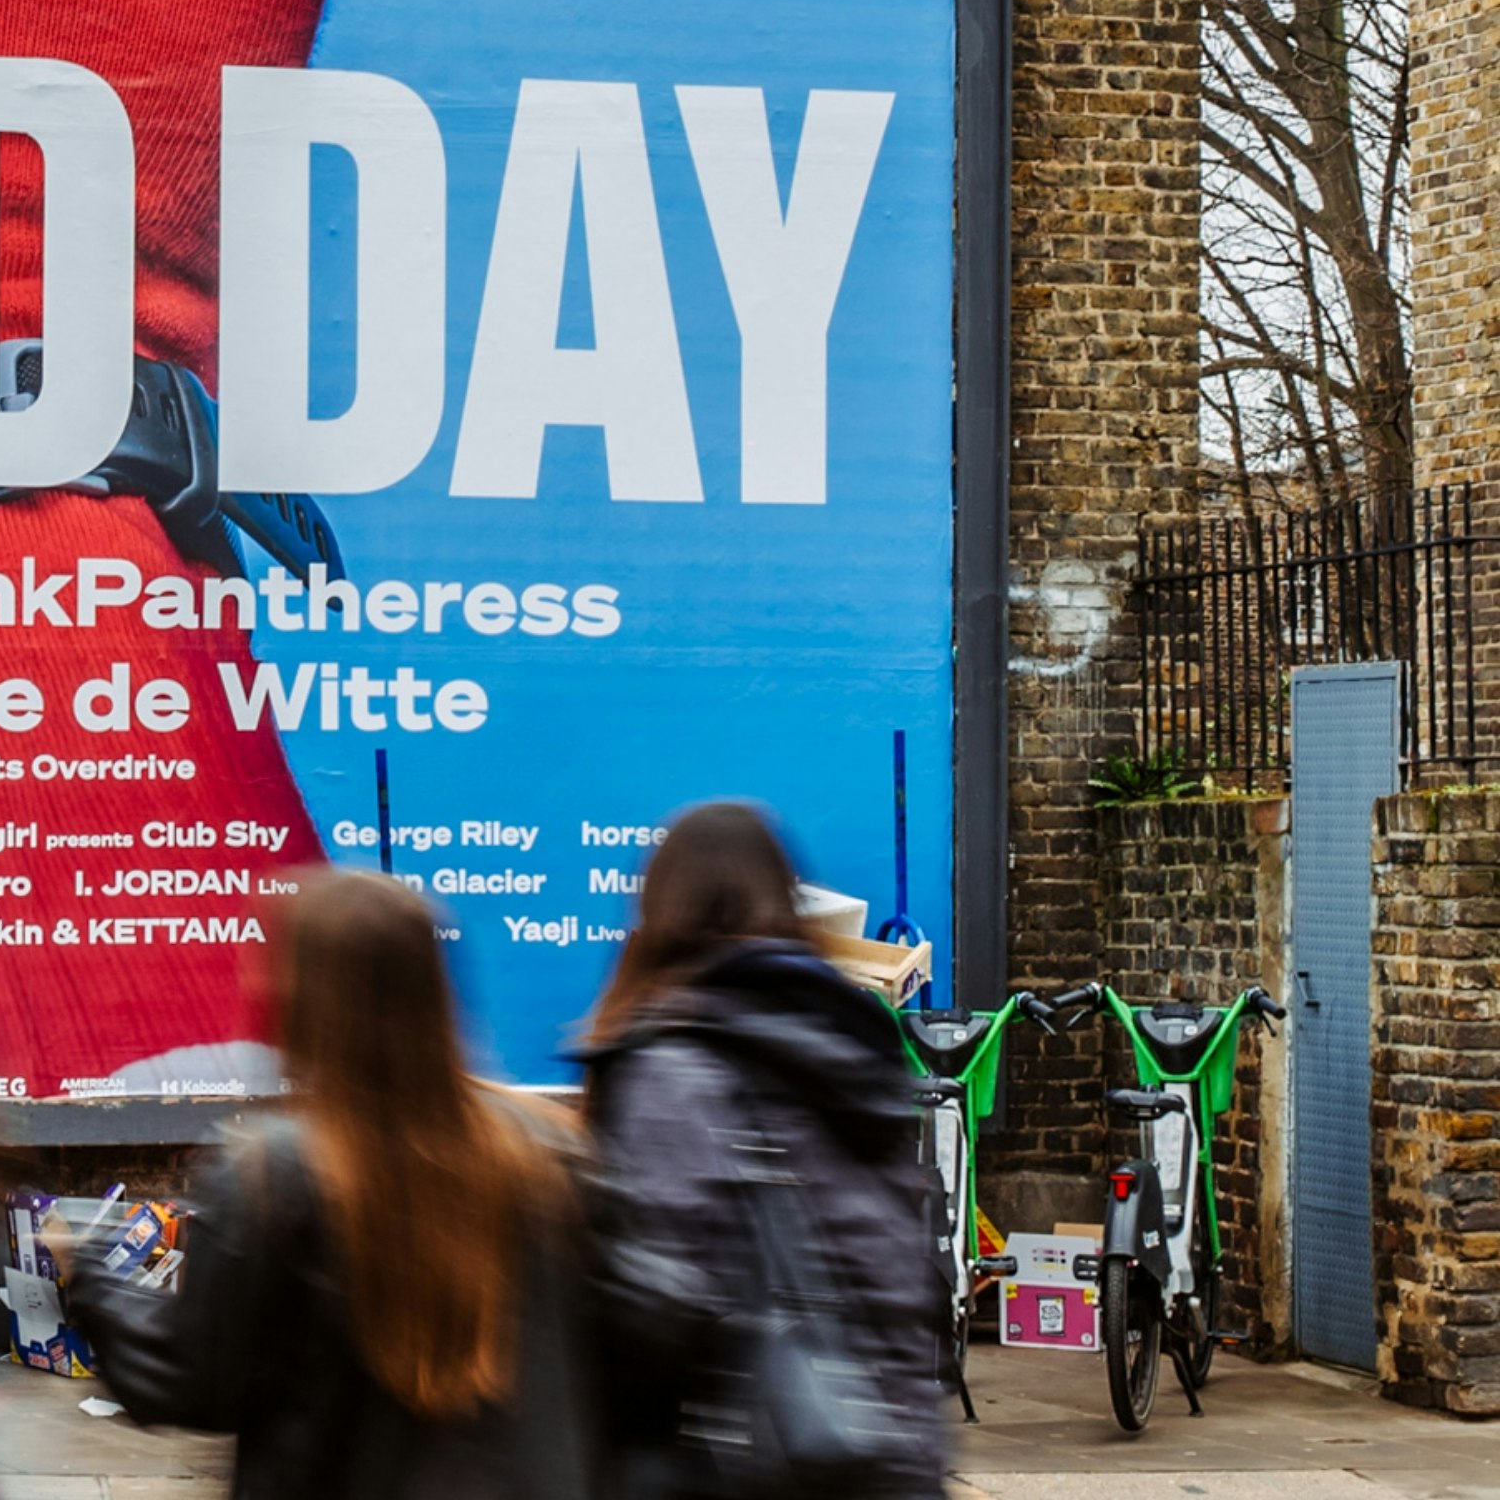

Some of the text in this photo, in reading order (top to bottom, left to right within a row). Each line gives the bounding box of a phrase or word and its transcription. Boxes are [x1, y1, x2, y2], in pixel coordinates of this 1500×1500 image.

[217, 64, 896, 505] DAY
[72, 661, 191, 733] de
[217, 660, 489, 733] Witte
[31, 753, 197, 782] Overdrive
[45, 832, 135, 851] presents
[141, 820, 218, 848] Club
[224, 820, 290, 852] Shy
[460, 820, 540, 852] Riley
[100, 869, 250, 897] JORDAN
[258, 878, 299, 896] Live
[432, 867, 547, 895] Glacier
[51, 918, 81, 945] &
[88, 917, 267, 945] KETTAMA
[503, 915, 579, 947] Yaeji
[585, 925, 627, 942] Live
